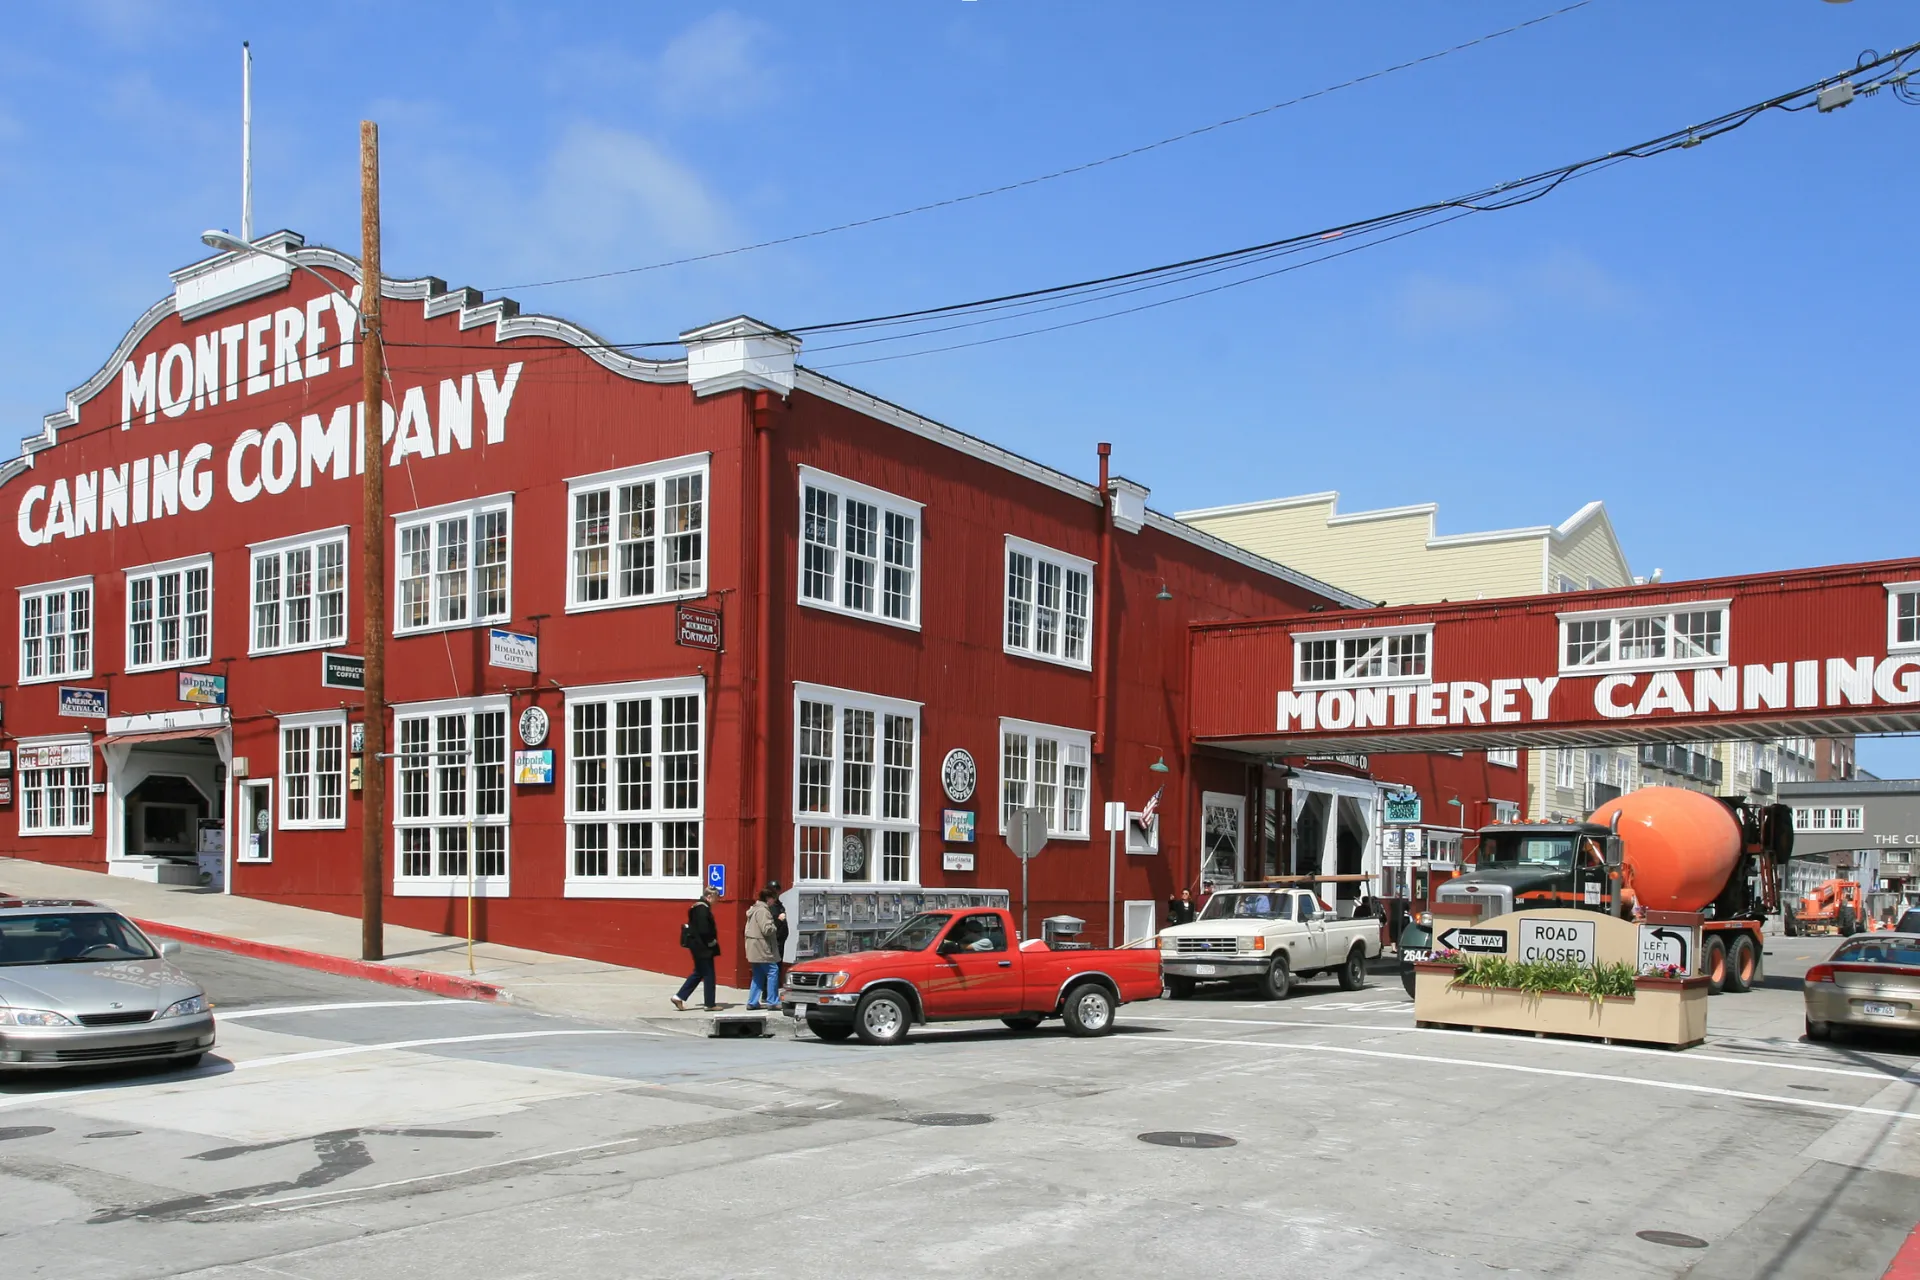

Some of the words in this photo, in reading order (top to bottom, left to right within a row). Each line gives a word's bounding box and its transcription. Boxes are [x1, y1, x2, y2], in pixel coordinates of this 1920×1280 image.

[121, 284, 363, 431] MONTEREY
[18, 443, 213, 547] CANNING
[681, 627, 718, 645] PORTRAITS
[494, 643, 534, 657] HIMALAYAN
[504, 653, 524, 664] GIFTS
[336, 671, 360, 679] COFFEE
[1276, 676, 1560, 731] MONTEREY
[1594, 656, 1920, 718] CANNING
[65, 696, 102, 706] AMERICAN
[62, 703, 92, 712] REVIVAL
[164, 718, 176, 728] 711
[20, 757, 37, 768] SALE
[49, 756, 61, 766] OFF
[945, 751, 974, 774] STARBUCKS
[949, 786, 971, 800] COFFEE
[1873, 834, 1899, 844] THE
[1535, 926, 1578, 942] ROAD
[1457, 935, 1477, 945] ONE
[1481, 936, 1502, 946] WAY
[1643, 941, 1668, 951] LEFT
[1526, 947, 1586, 963] CLOSED
[1643, 951, 1670, 962] TURN
